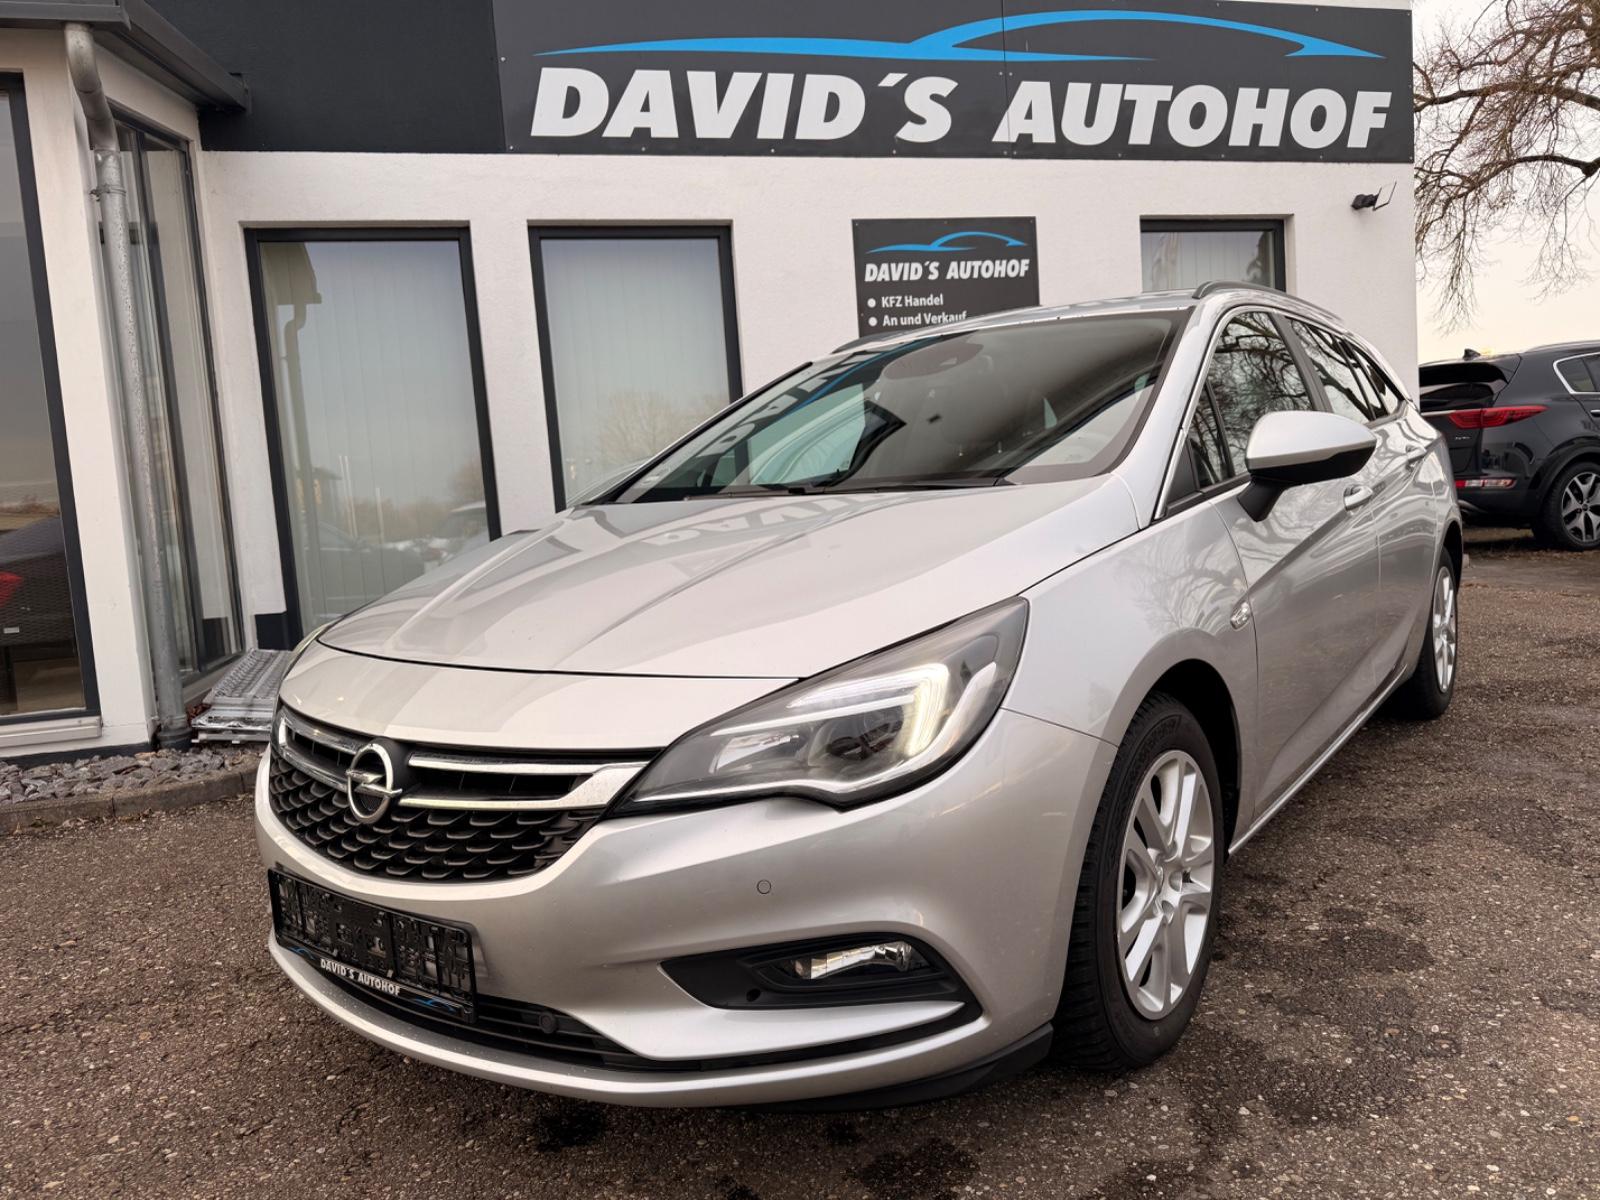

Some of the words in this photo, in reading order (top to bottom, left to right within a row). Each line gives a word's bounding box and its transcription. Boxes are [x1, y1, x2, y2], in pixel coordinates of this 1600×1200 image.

[992, 80, 1393, 149] AUTOHOF
[946, 258, 1030, 280] AUTOHOF
[881, 295, 903, 308] KFZ
[904, 293, 944, 307] Handel
[882, 314, 898, 327] An
[900, 313, 922, 326] und
[923, 310, 968, 324] Verkauf
[357, 971, 401, 996] AUTOHOF
